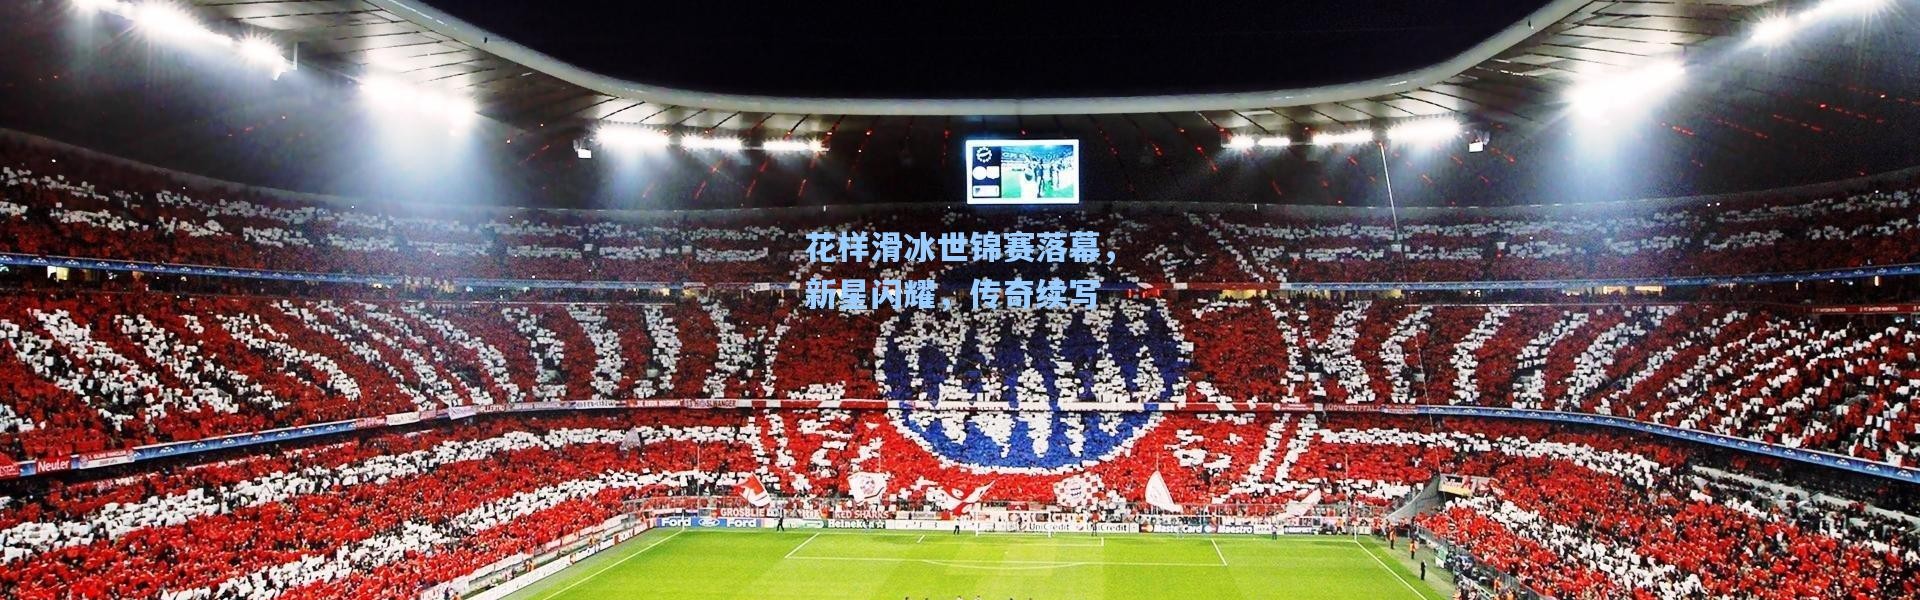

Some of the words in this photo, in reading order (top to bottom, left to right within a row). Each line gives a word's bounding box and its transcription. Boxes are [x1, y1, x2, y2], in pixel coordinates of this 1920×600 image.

[37, 459, 70, 473] Neuler
[854, 509, 889, 520] SHARKS
[661, 517, 691, 527] Ford
[726, 517, 757, 528] Ford
[1029, 521, 1069, 532] UniCredit
